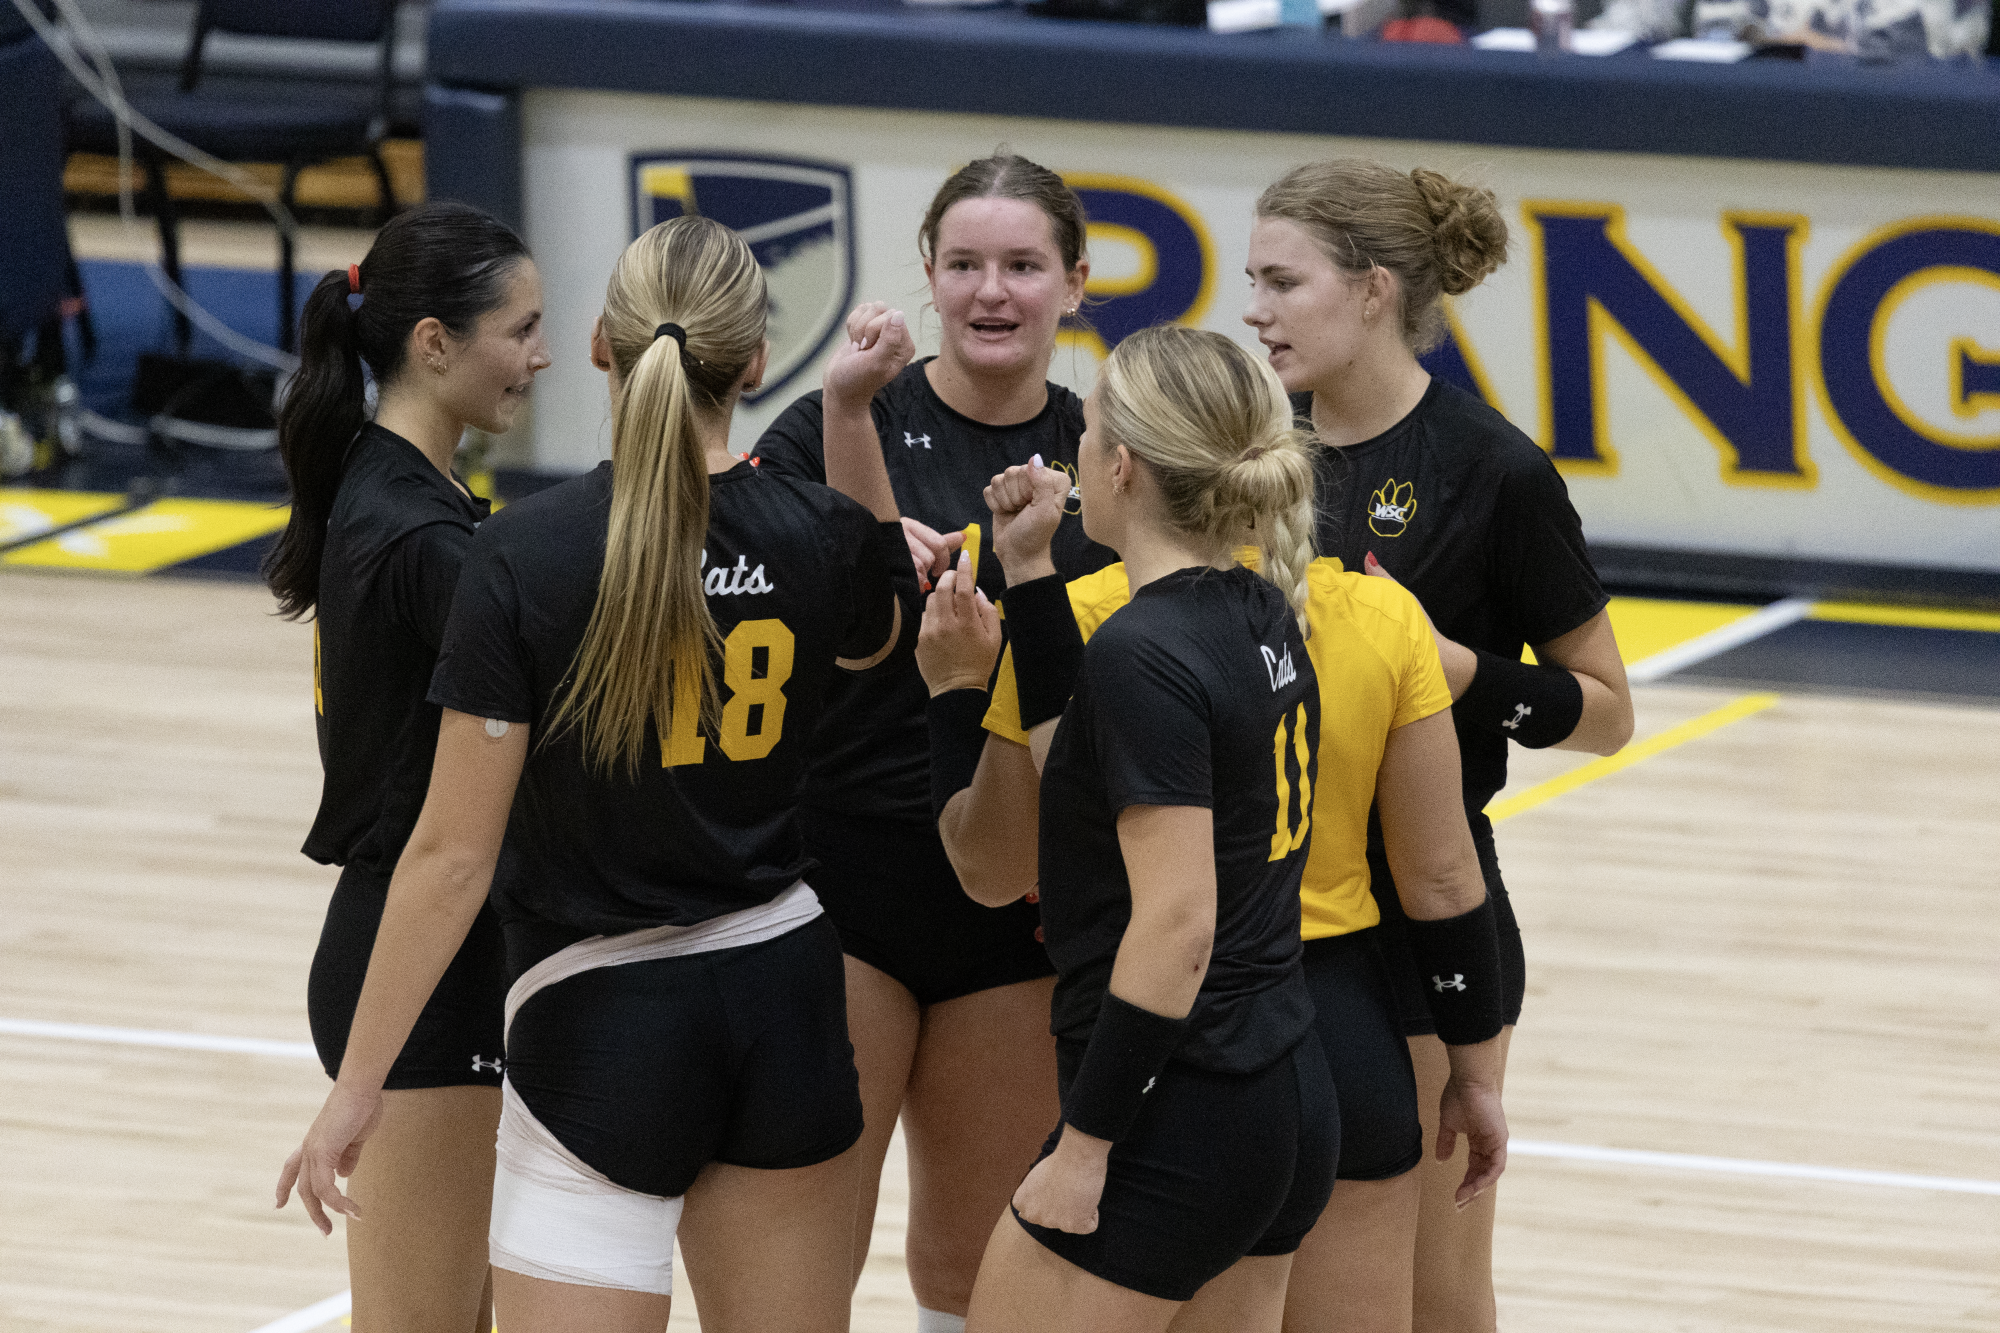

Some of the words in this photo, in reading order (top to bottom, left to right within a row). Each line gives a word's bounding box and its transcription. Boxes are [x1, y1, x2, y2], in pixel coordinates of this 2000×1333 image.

[950, 164, 2000, 508] RNG
[1374, 502, 1408, 521] WSC
[661, 618, 795, 768] 18
[1260, 642, 1297, 692] Cats
[1267, 701, 1312, 862] 11
